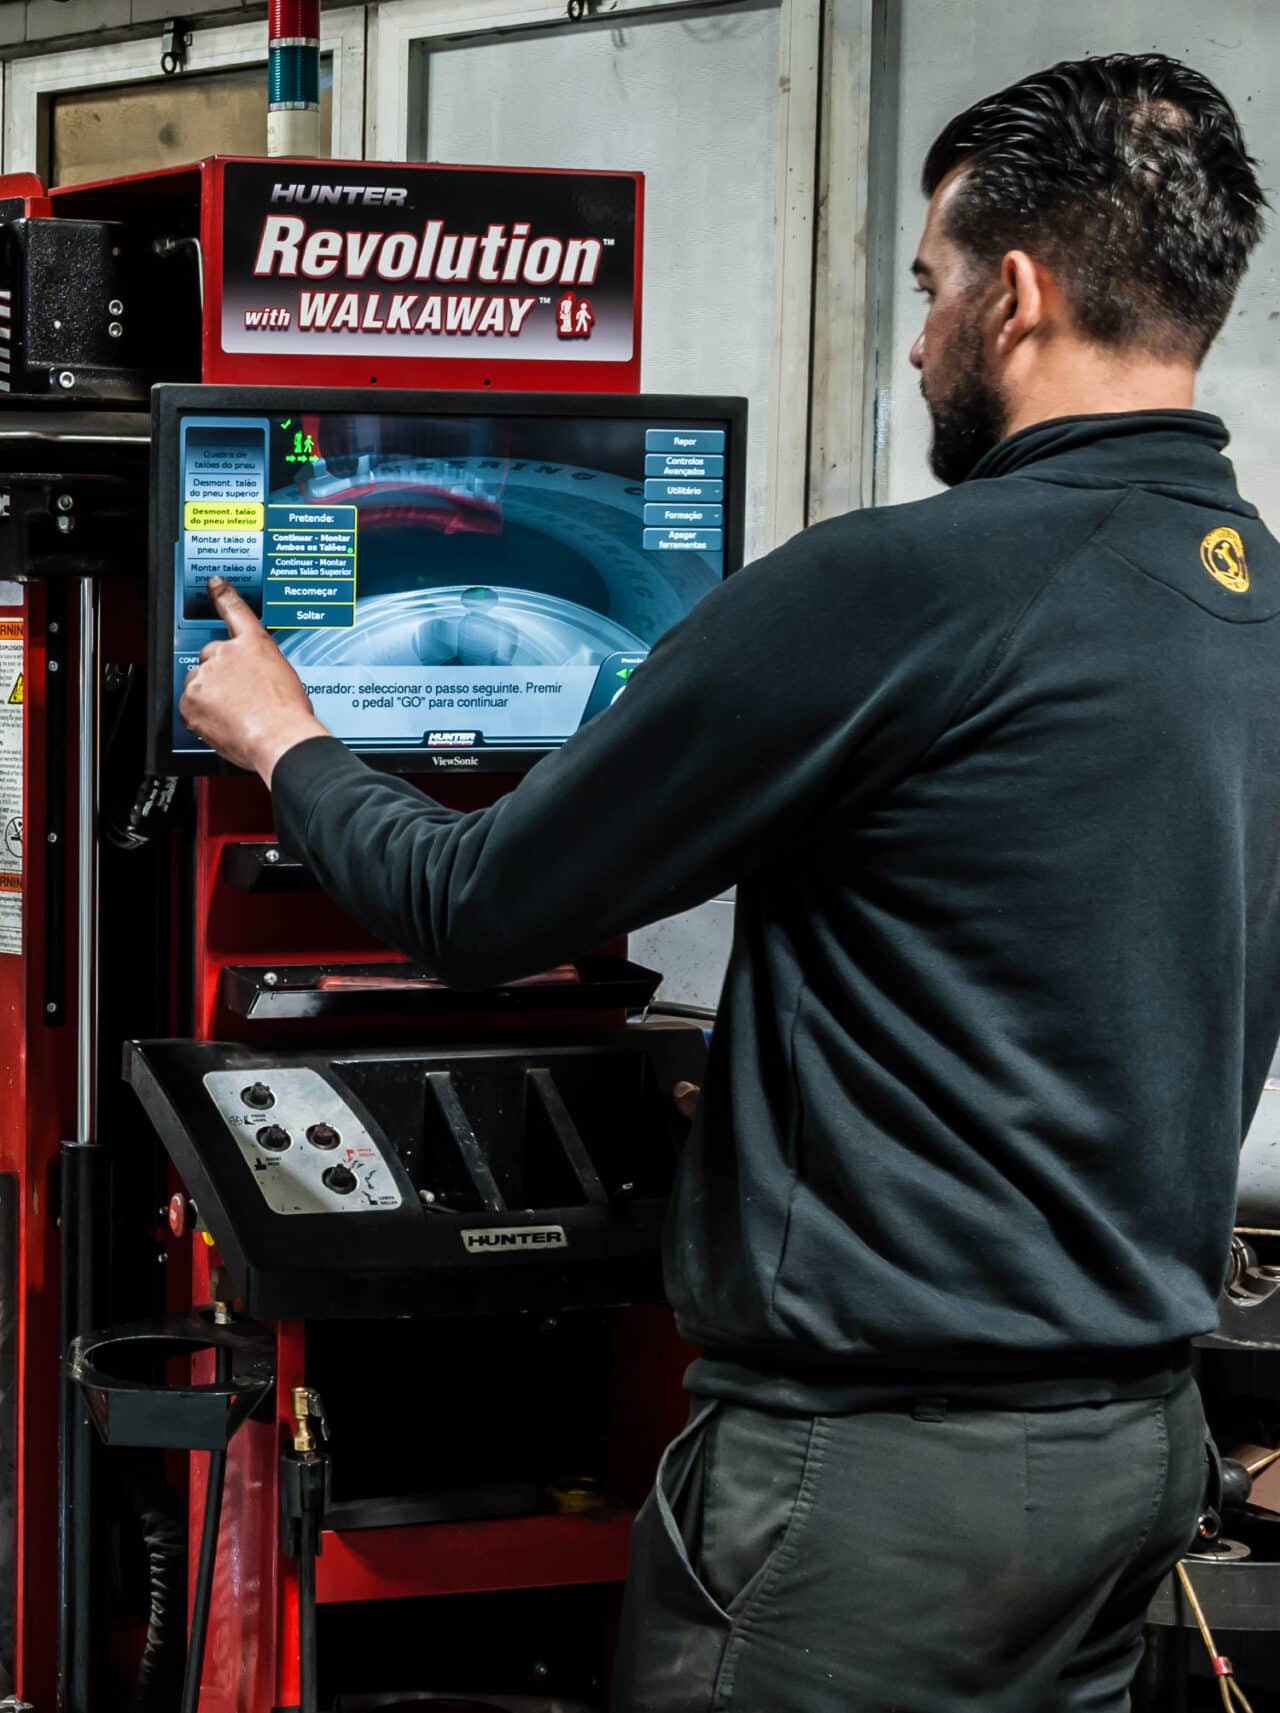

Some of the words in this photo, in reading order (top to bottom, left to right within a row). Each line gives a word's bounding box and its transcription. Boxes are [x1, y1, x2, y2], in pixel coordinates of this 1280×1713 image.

[271, 183, 407, 207] HUNTER
[254, 215, 602, 286] Revolution
[245, 307, 290, 329] with
[298, 291, 536, 333] WALKAWAY
[285, 587, 338, 597] Recomeçar
[296, 611, 325, 621] Soltar
[358, 683, 422, 694] seleccionar
[425, 685, 432, 694] o
[435, 684, 469, 696] passo
[472, 683, 523, 696] seguinte.
[526, 682, 563, 694] Premir
[352, 698, 359, 708] o
[362, 696, 394, 710] pedal
[429, 699, 454, 710] para
[457, 696, 509, 708] continuar
[432, 756, 479, 766] ViewSonic
[468, 1232, 562, 1247] HUNTER
